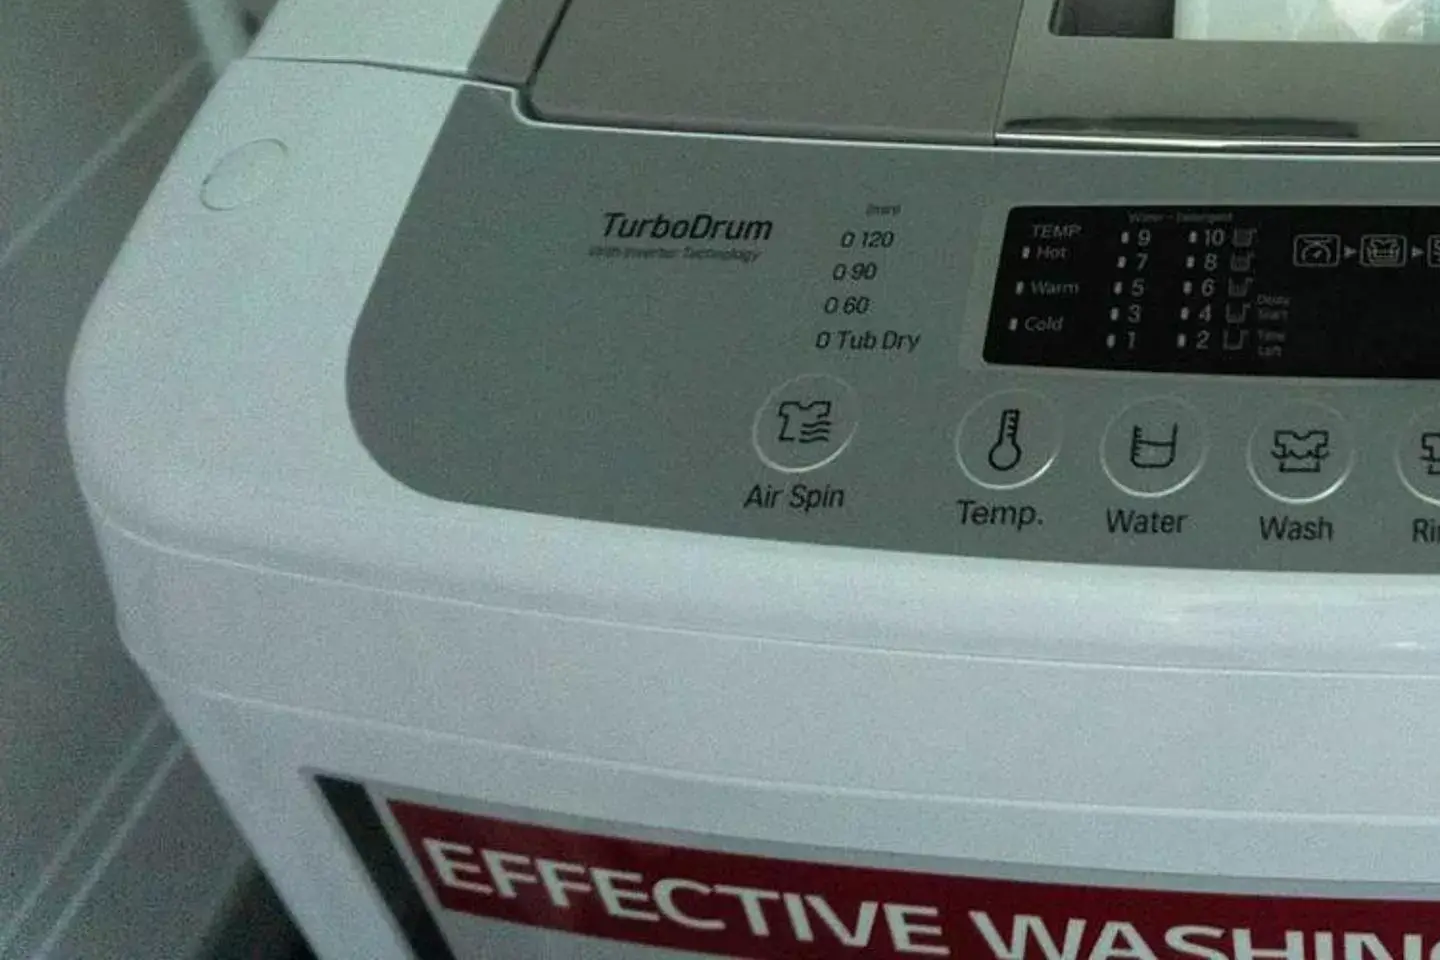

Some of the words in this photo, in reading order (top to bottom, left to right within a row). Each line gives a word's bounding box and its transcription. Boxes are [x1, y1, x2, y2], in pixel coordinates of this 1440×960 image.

[603, 212, 773, 241] TurboDrum
[1032, 224, 1082, 240] TEMP
[860, 230, 895, 249] 120
[1138, 229, 1150, 247] 9
[1204, 228, 1225, 247] 10
[1036, 245, 1068, 260] Hot
[851, 262, 878, 281] 90
[1136, 253, 1149, 272] 7
[1203, 253, 1218, 272] 8
[1031, 281, 1079, 296] Warm
[1131, 279, 1145, 298] 5
[1201, 278, 1216, 297] 6
[843, 296, 871, 315] 60
[1127, 305, 1141, 324] 3
[1199, 305, 1213, 323] 4
[1024, 316, 1064, 332] Cold
[838, 330, 877, 351] Tub
[881, 330, 921, 353] Dry
[1126, 330, 1137, 349] 1
[1196, 330, 1210, 350] 2
[744, 485, 784, 509] Air
[788, 484, 845, 511] Spin
[956, 499, 1044, 528] Temp.
[1105, 509, 1188, 535] Water
[1259, 515, 1335, 542] Wash
[421, 837, 950, 957] EFFECTIVE
